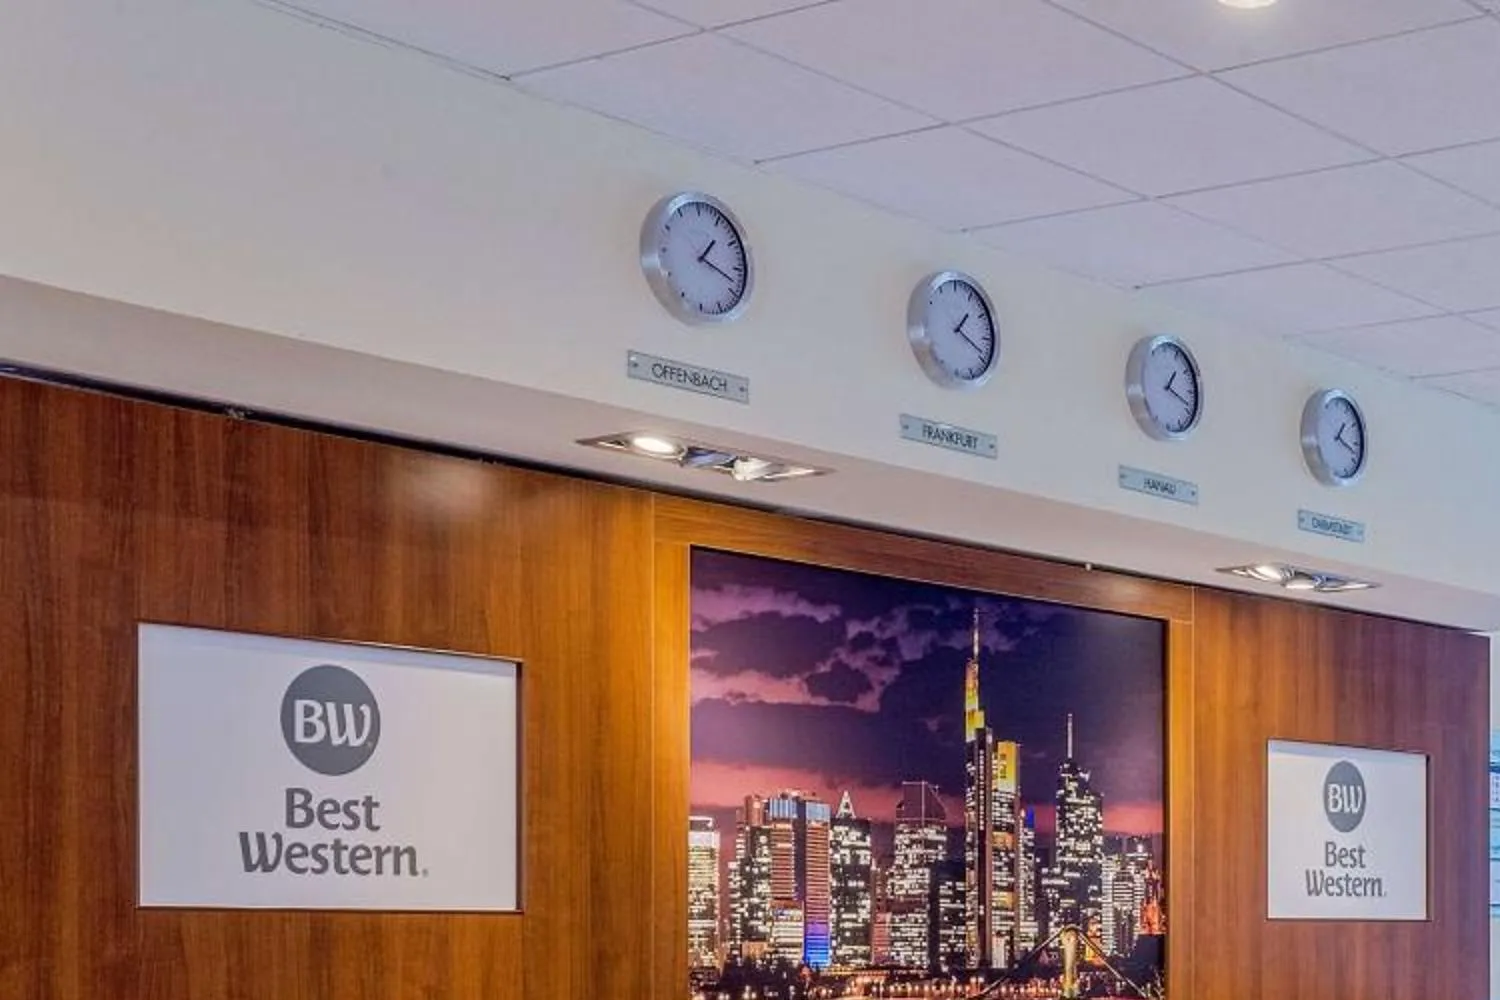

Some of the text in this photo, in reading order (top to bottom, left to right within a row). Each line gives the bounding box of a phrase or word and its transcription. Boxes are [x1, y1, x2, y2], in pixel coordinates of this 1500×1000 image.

[651, 362, 727, 392] OFFENBACH
[922, 424, 978, 449] FRANKFURT
[294, 699, 370, 746] BW
[284, 787, 381, 831] Best
[1328, 783, 1362, 814] BW
[238, 831, 418, 877] Western
[1325, 841, 1366, 868] Best
[1305, 869, 1382, 897] Western
